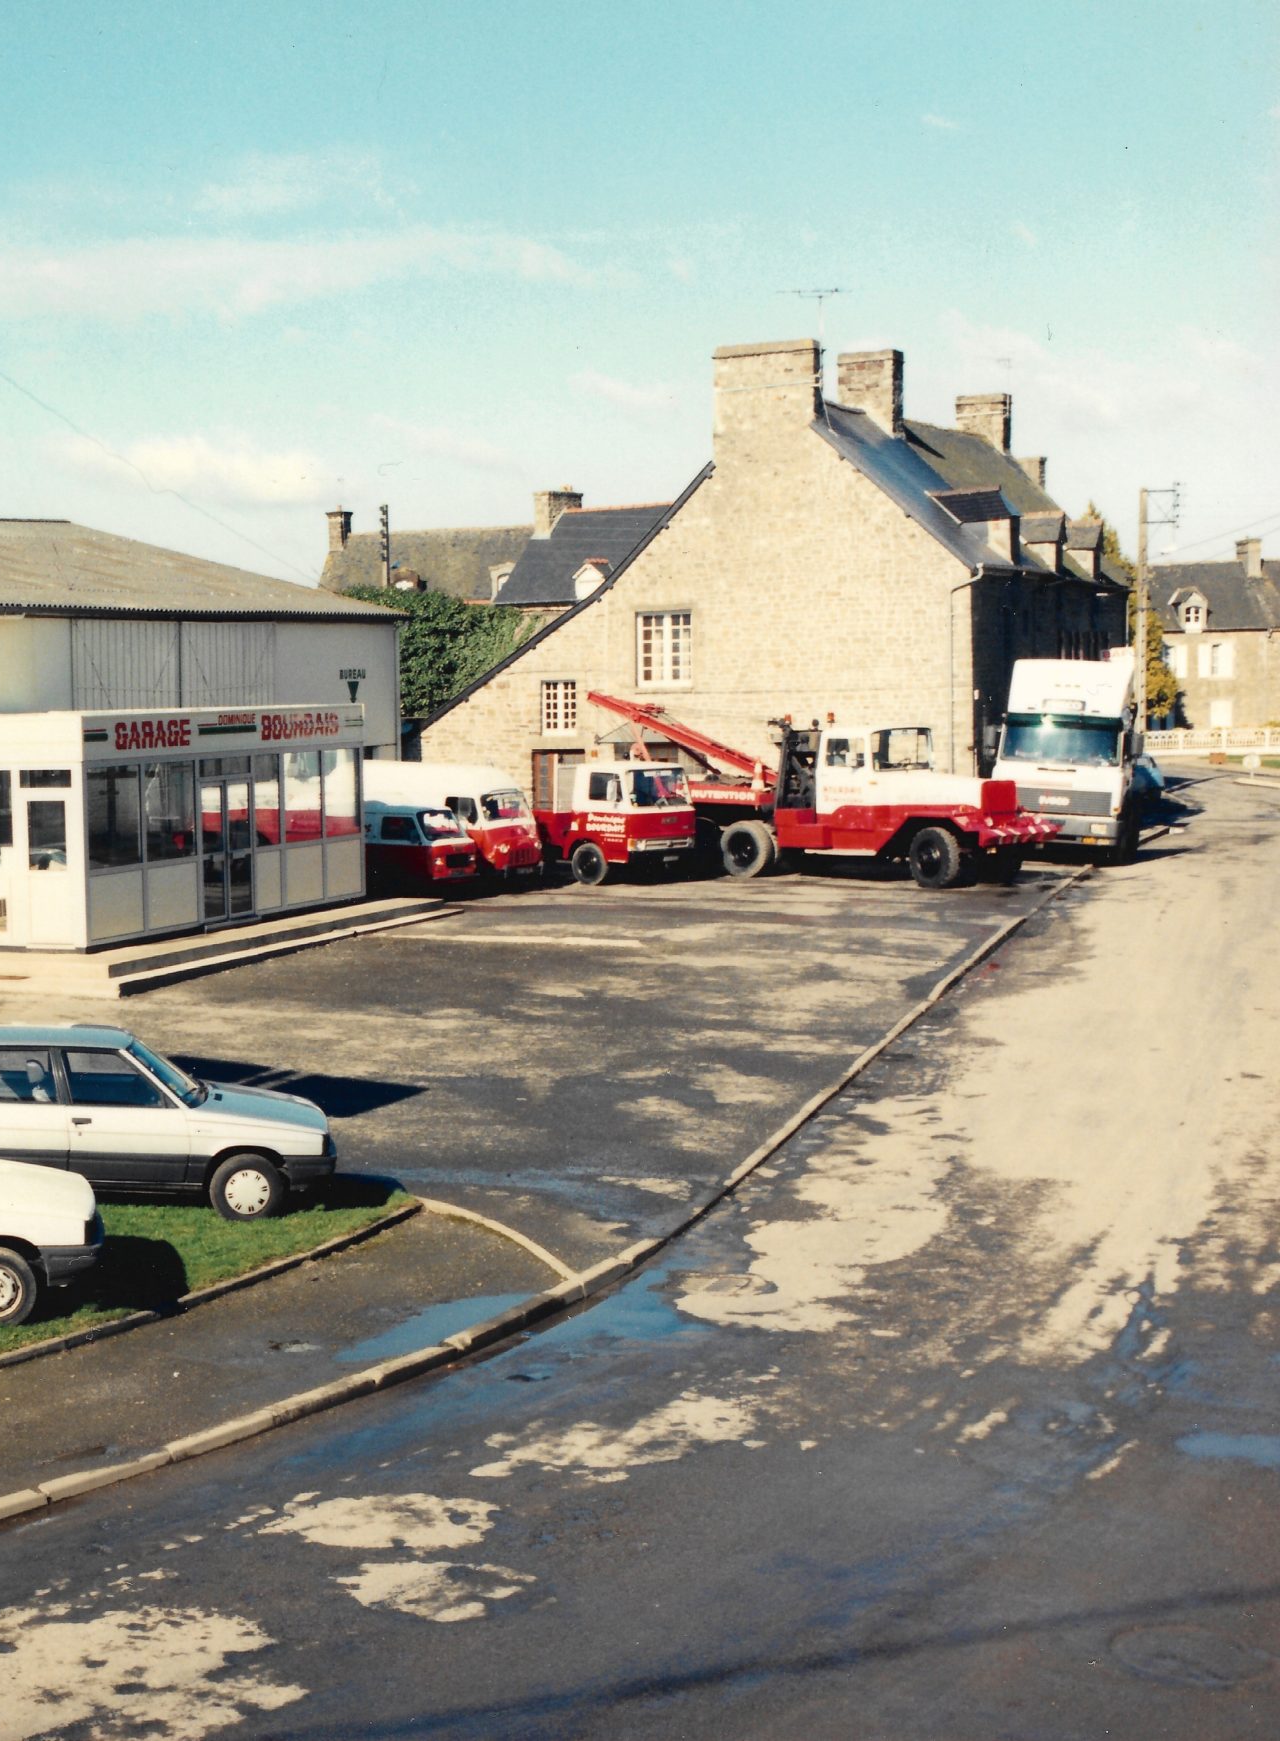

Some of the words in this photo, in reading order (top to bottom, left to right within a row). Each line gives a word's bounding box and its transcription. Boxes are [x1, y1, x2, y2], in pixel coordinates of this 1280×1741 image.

[339, 669, 366, 680] BUREAU
[115, 719, 192, 750] GARAGE
[218, 713, 256, 725] DOMINIQUE
[261, 712, 339, 741] BOURDAIS
